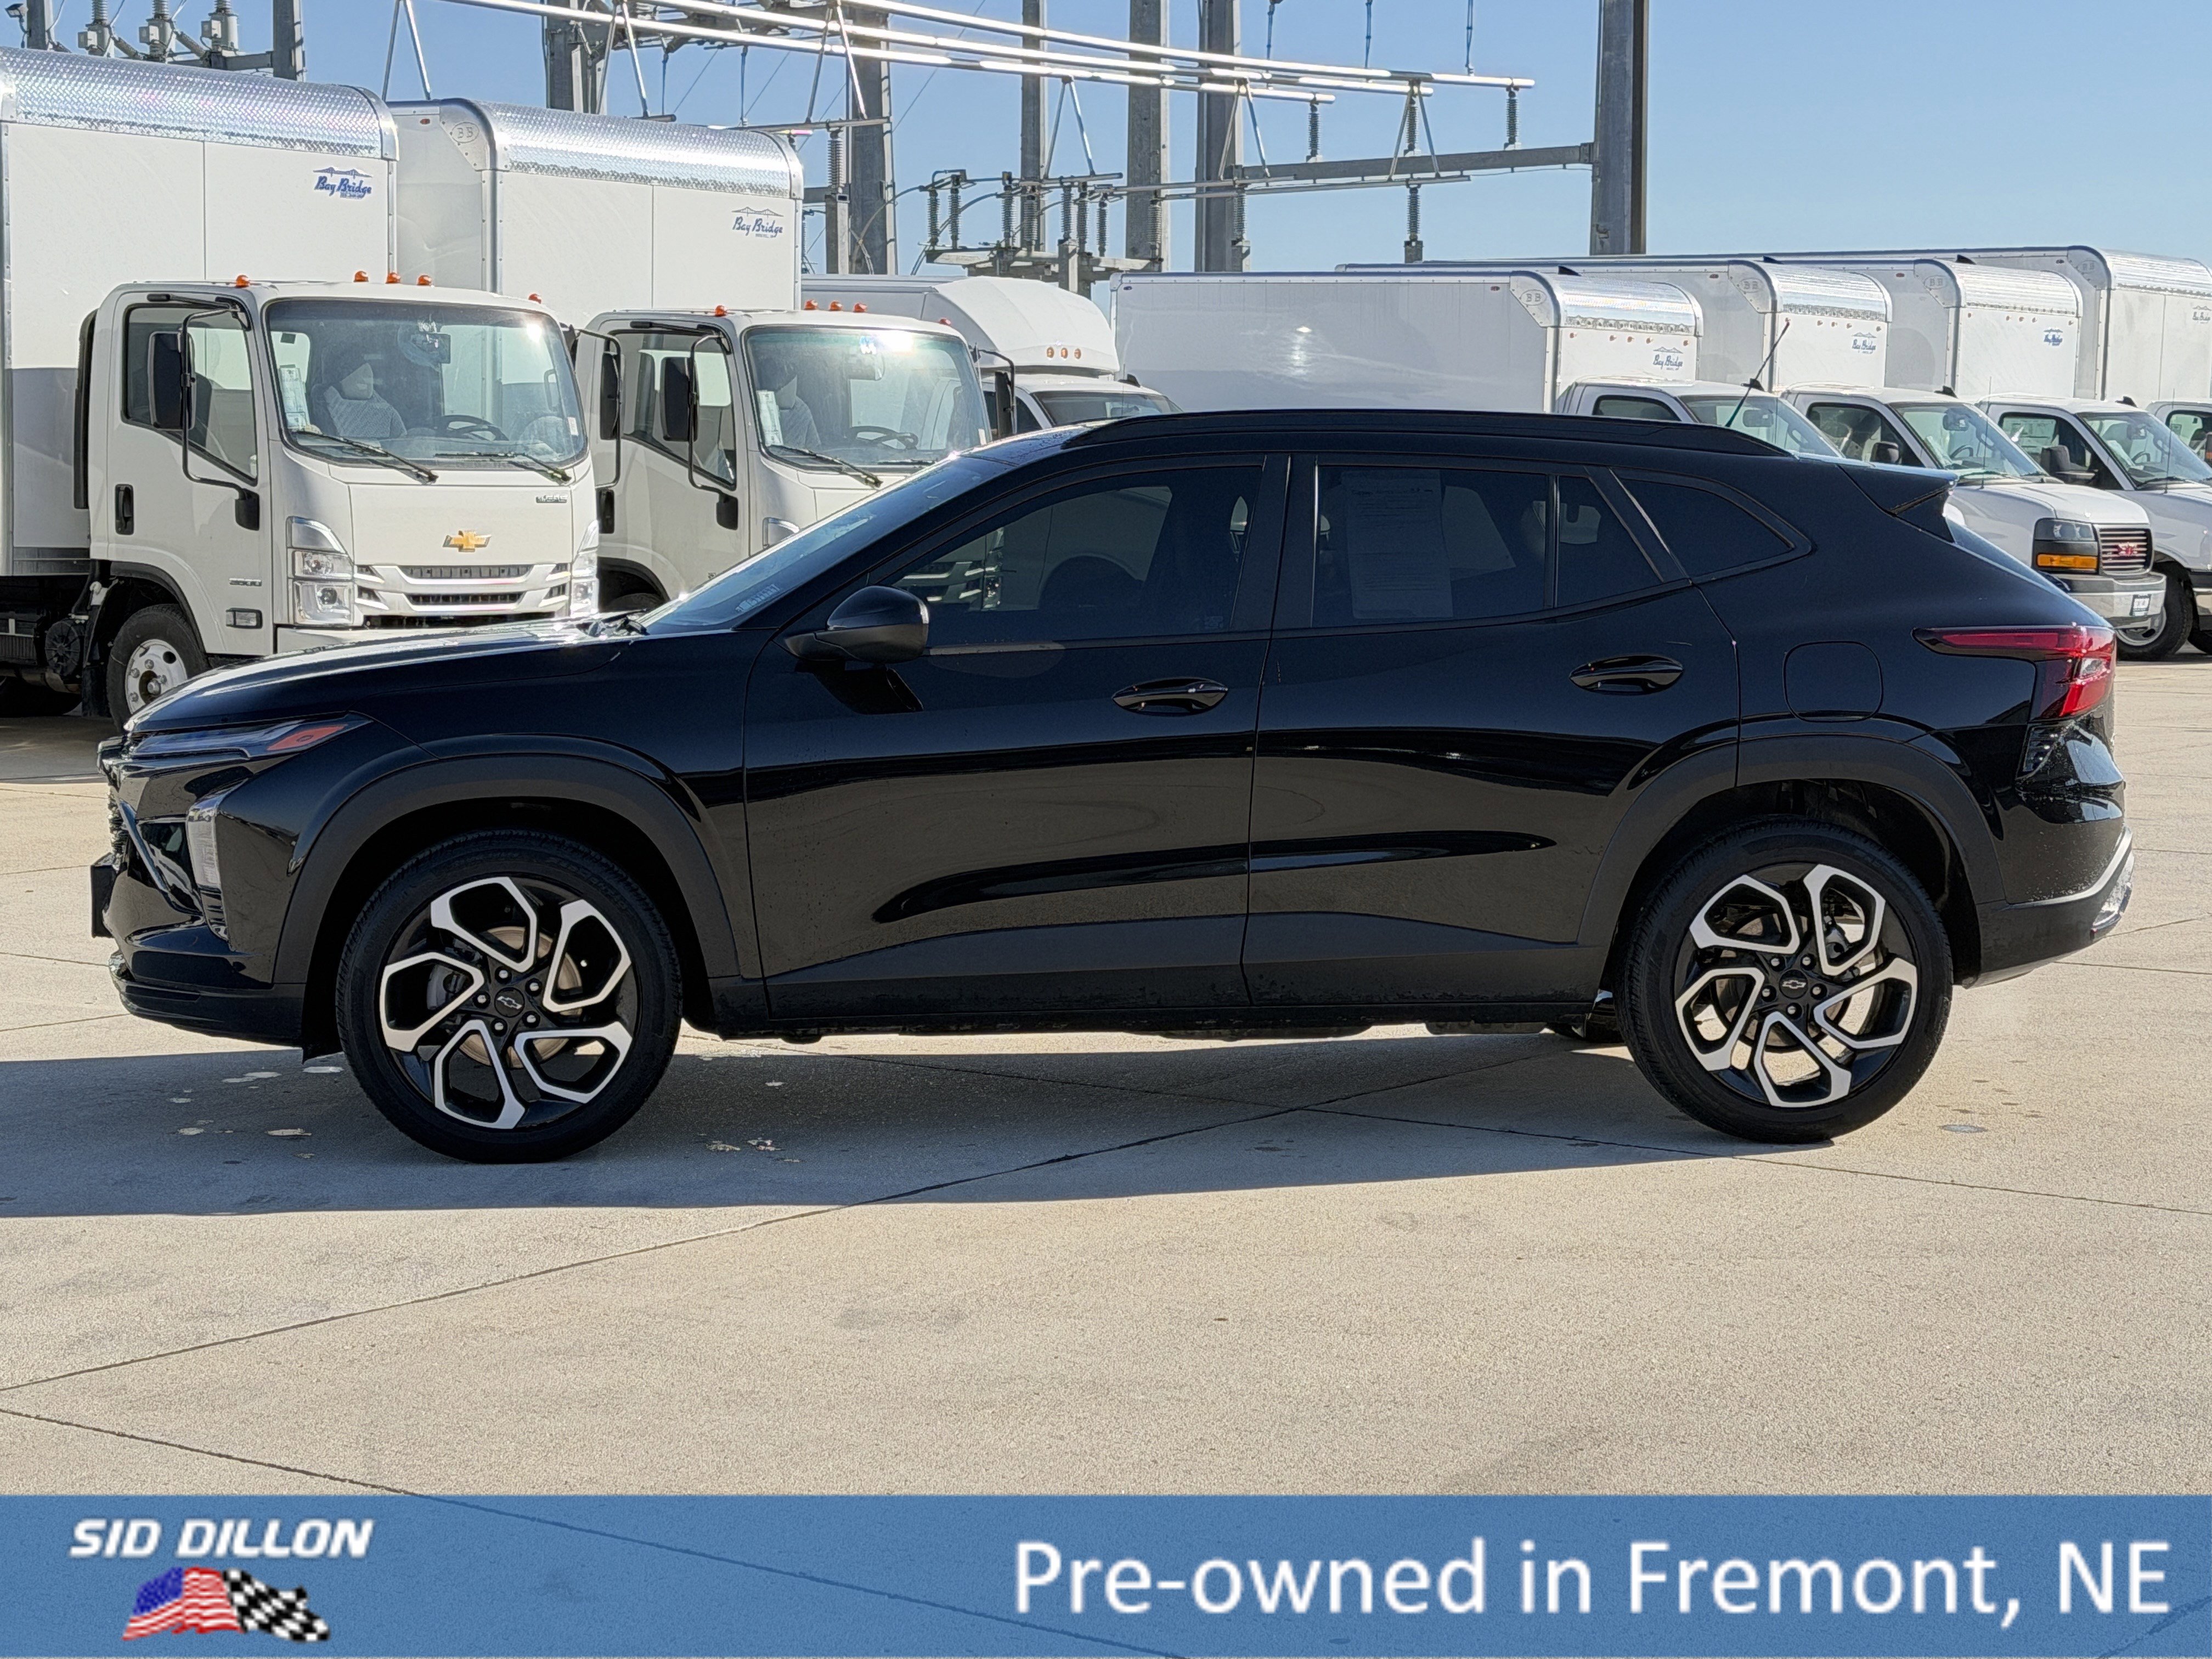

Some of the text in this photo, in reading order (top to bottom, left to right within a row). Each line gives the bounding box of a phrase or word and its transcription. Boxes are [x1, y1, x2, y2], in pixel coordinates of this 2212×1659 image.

[313, 175, 372, 198] Bay Bridge
[732, 216, 783, 238] Bay Bridge
